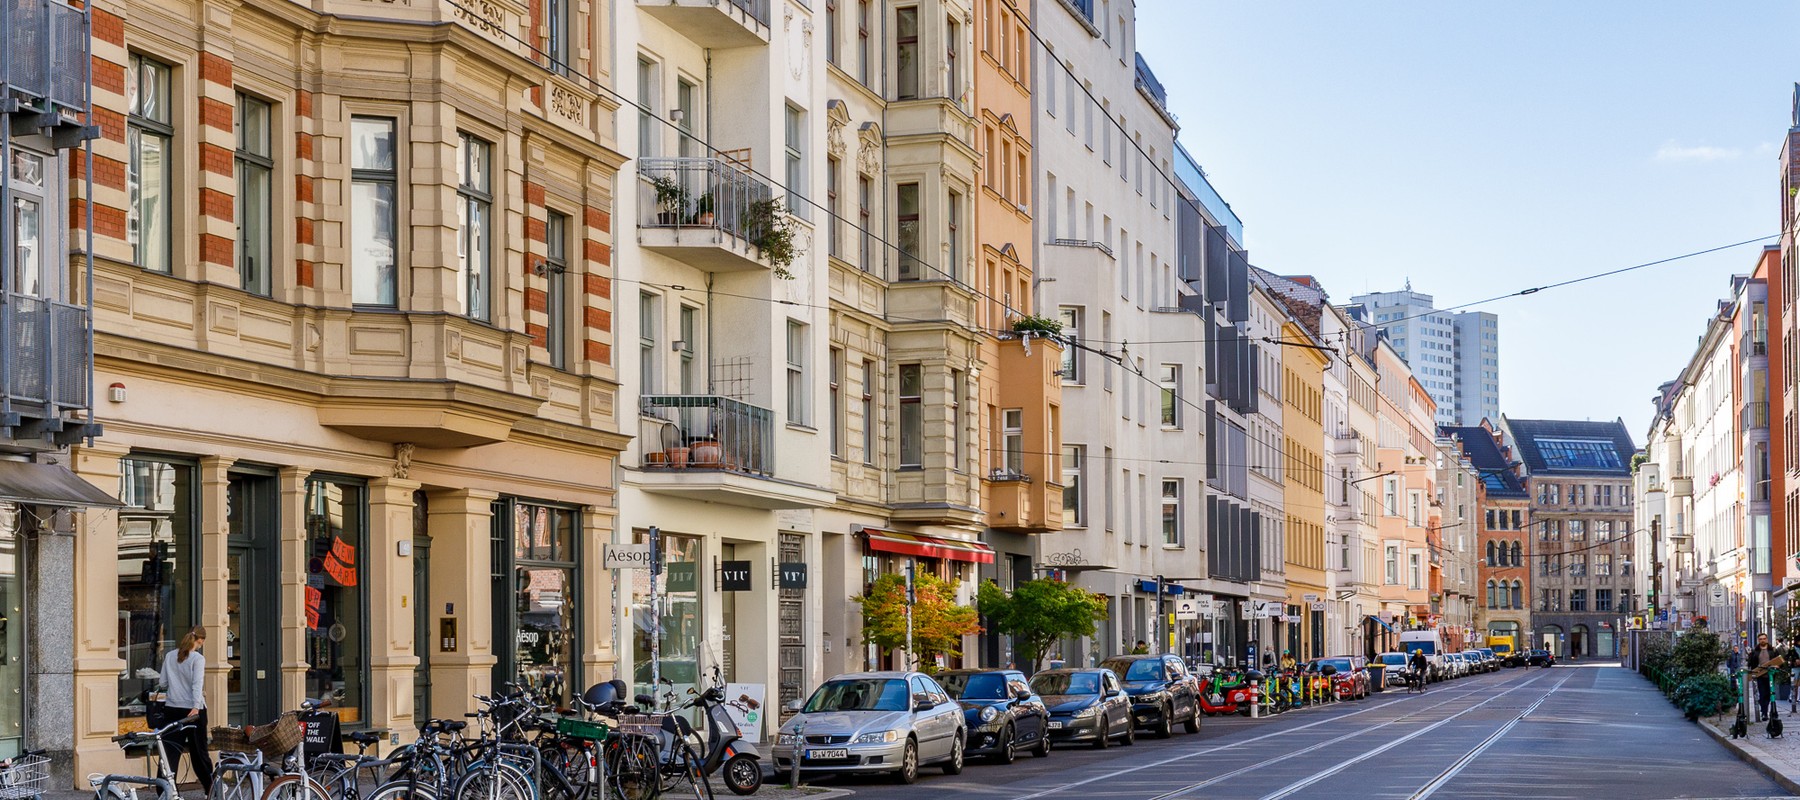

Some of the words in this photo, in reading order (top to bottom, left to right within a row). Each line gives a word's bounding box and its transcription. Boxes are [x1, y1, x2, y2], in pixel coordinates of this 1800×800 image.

[333, 540, 355, 561] NEW
[325, 555, 356, 581] START
[724, 571, 748, 581] VIU
